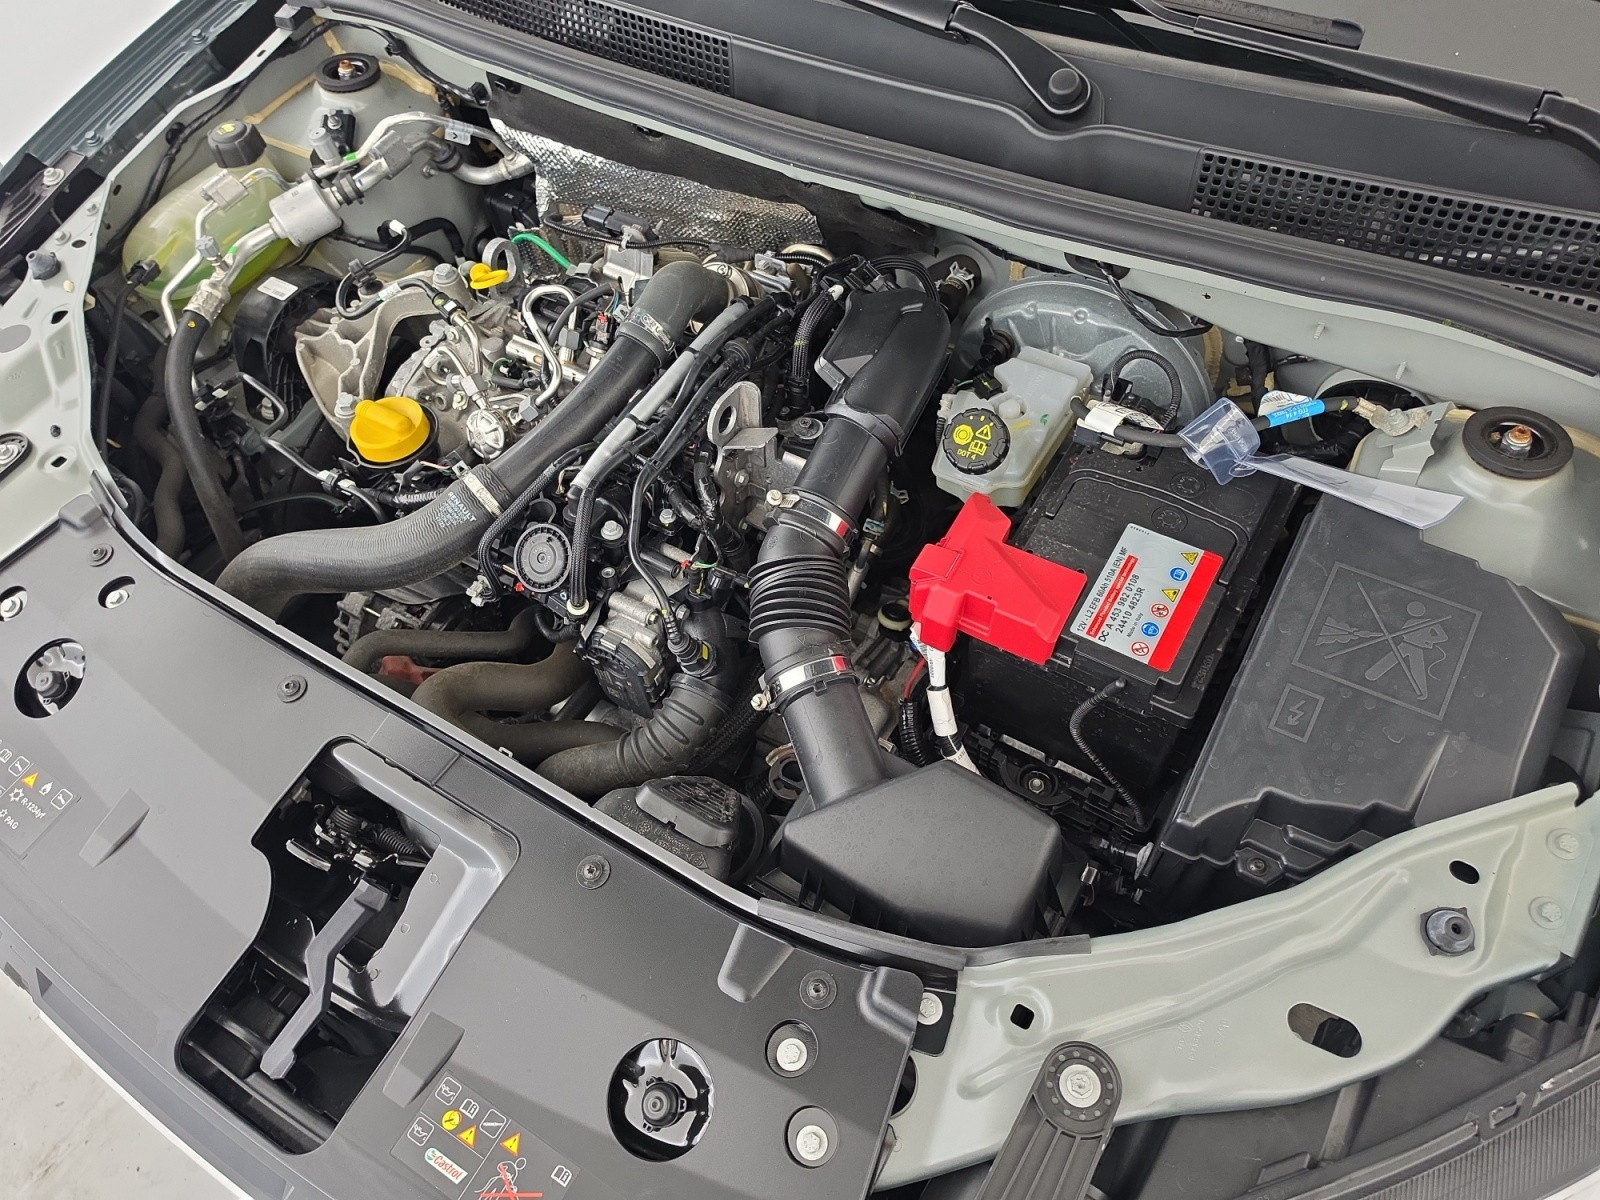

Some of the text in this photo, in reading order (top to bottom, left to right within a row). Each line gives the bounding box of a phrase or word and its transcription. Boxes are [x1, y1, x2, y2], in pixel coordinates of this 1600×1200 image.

[957, 449, 971, 458] DOT
[449, 491, 477, 522] RENAULT
[1076, 620, 1087, 632] 12V
[1084, 608, 1093, 618] L2
[1089, 596, 1100, 610] EFB
[1096, 581, 1108, 597] 60Ah
[1104, 567, 1116, 582] 510A
[1119, 546, 1128, 556] MF
[1105, 621, 1113, 629] A
[1109, 607, 1122, 622] 453
[1117, 592, 1130, 607] 982
[1125, 573, 1139, 592] 0108
[1115, 586, 1145, 634] 24410 4823R
[20, 797, 46, 819] R-1234yf
[4, 816, 19, 830] PAG
[433, 1155, 462, 1180] Castrol
